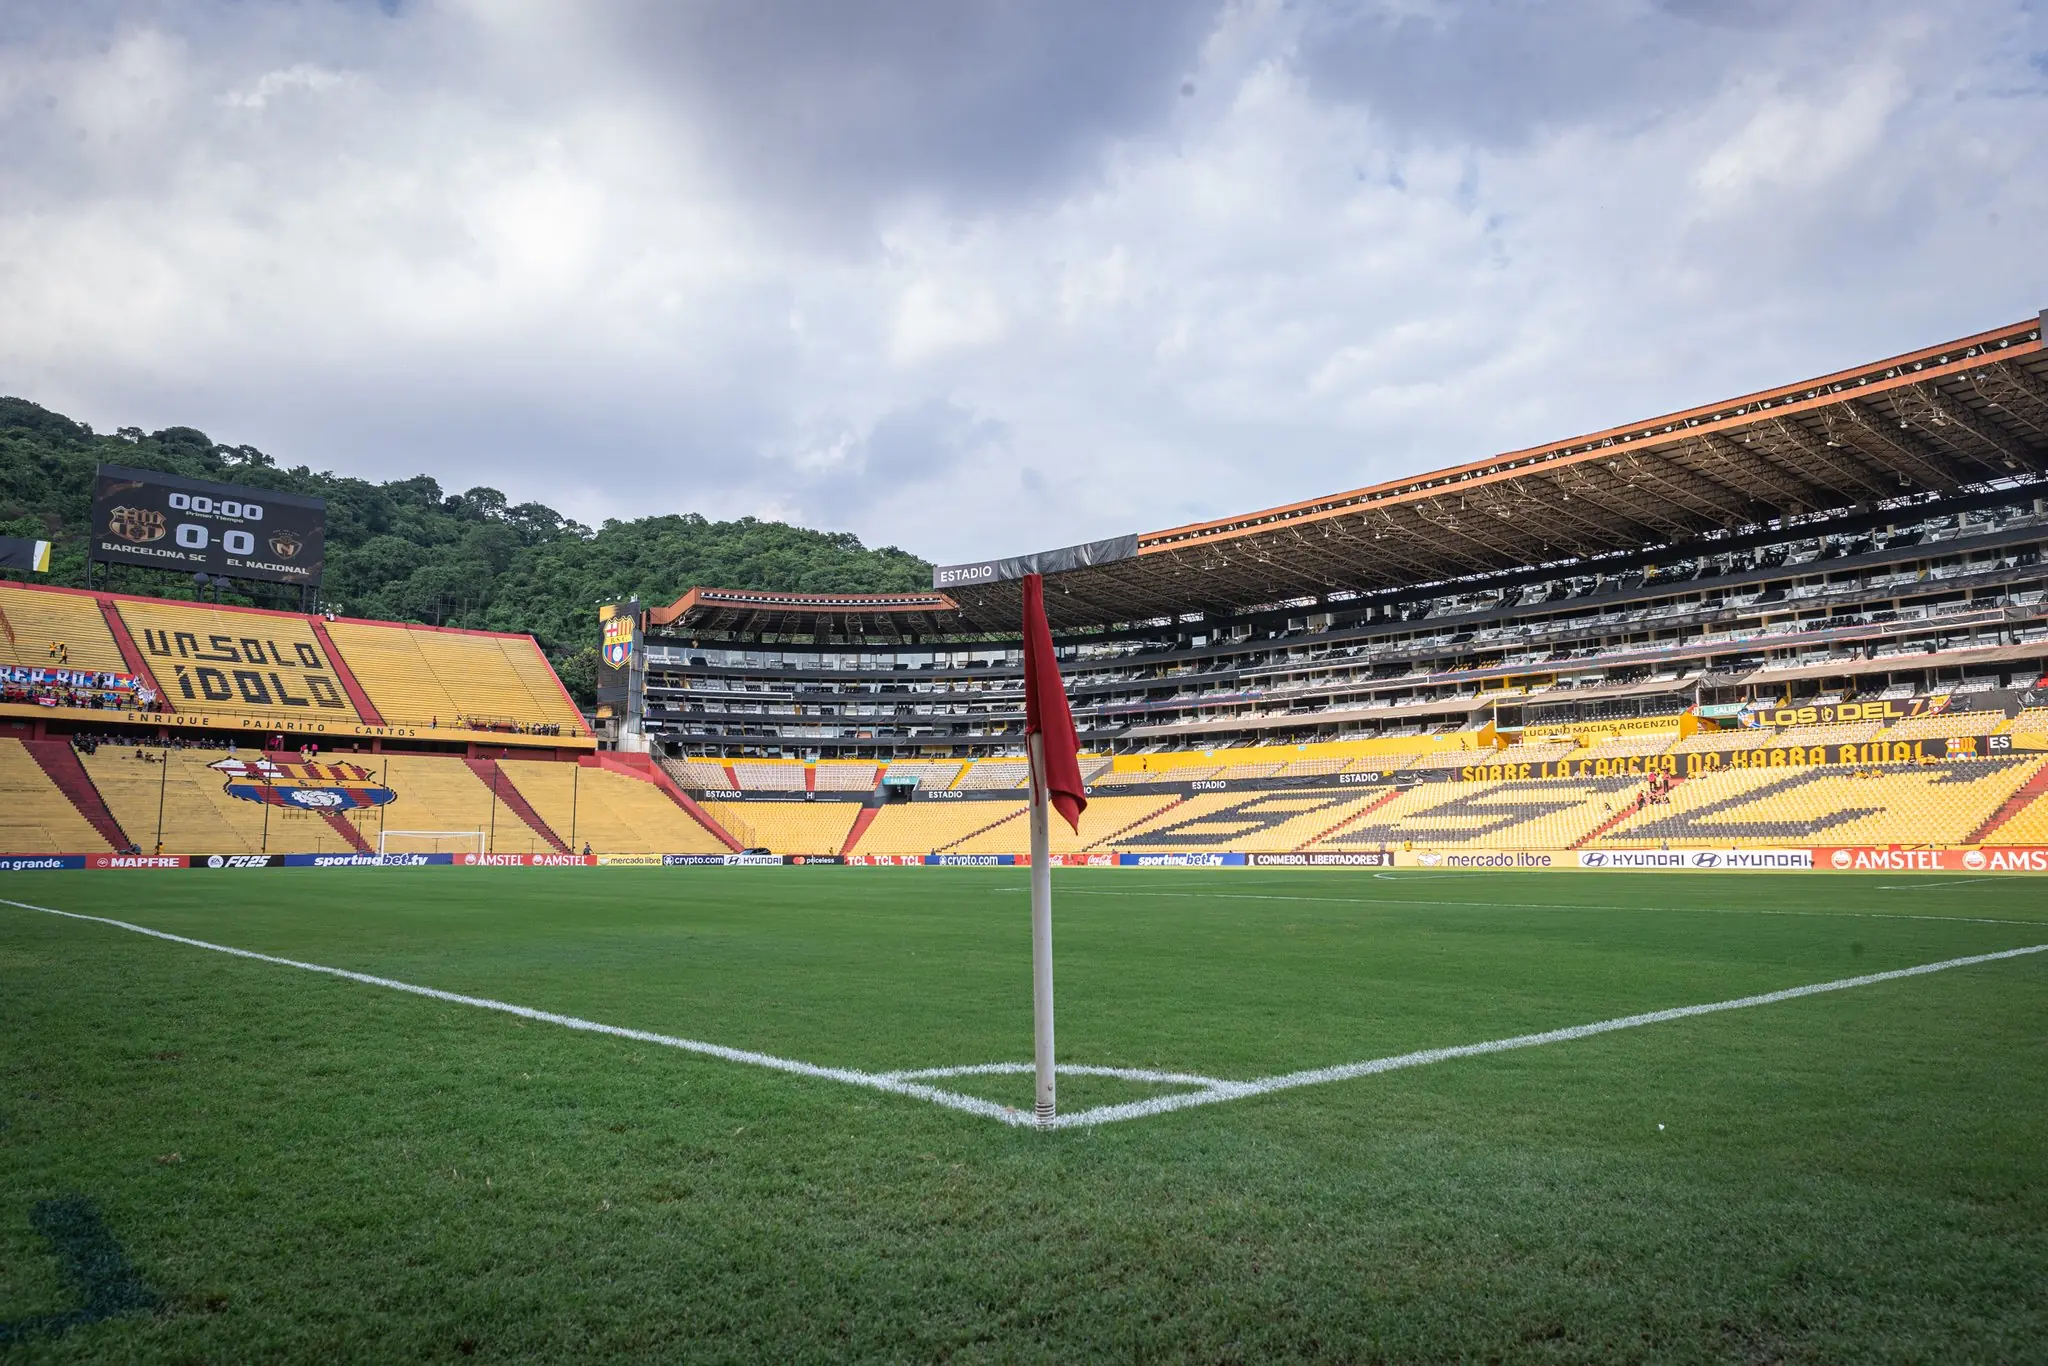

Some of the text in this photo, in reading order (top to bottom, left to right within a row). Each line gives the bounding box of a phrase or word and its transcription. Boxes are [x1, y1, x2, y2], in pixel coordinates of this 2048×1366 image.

[169, 493, 263, 520] 00:00
[102, 542, 206, 562] BARCELONA SC
[226, 558, 310, 575] EL NACIONAL
[940, 565, 992, 583] ESTADIO
[1758, 706, 1817, 726] LOS
[1837, 701, 1904, 720] DEL
[128, 713, 415, 738] ENRIQUE PAJARITO CANTOS
[1573, 723, 1616, 734] MACIAS
[1618, 719, 1679, 730] ARGENZIO
[1339, 772, 1379, 784] ESTADIO
[1191, 780, 1226, 790] ESTADIO
[928, 791, 963, 799] ESTADIO
[111, 857, 179, 867] MAPFRE
[314, 854, 428, 866] sportingbet.tv
[478, 855, 523, 866] AMSTEL
[544, 855, 587, 866] AMSTEL
[644, 856, 661, 864] libre
[674, 856, 724, 866] crypto.com
[806, 856, 835, 865] priceless
[848, 856, 868, 865] TCL
[874, 856, 894, 865] TCL
[901, 856, 922, 865] TCL
[947, 855, 998, 866] crypto.com
[1309, 854, 1379, 865] LIBERTADORES
[1447, 852, 1551, 867] mercado libre
[1613, 855, 1685, 866] HYUNDAI
[1726, 854, 1810, 866] HYUNDAI
[1855, 851, 1944, 869] AMSTEL
[1989, 850, 2048, 871] AMS
